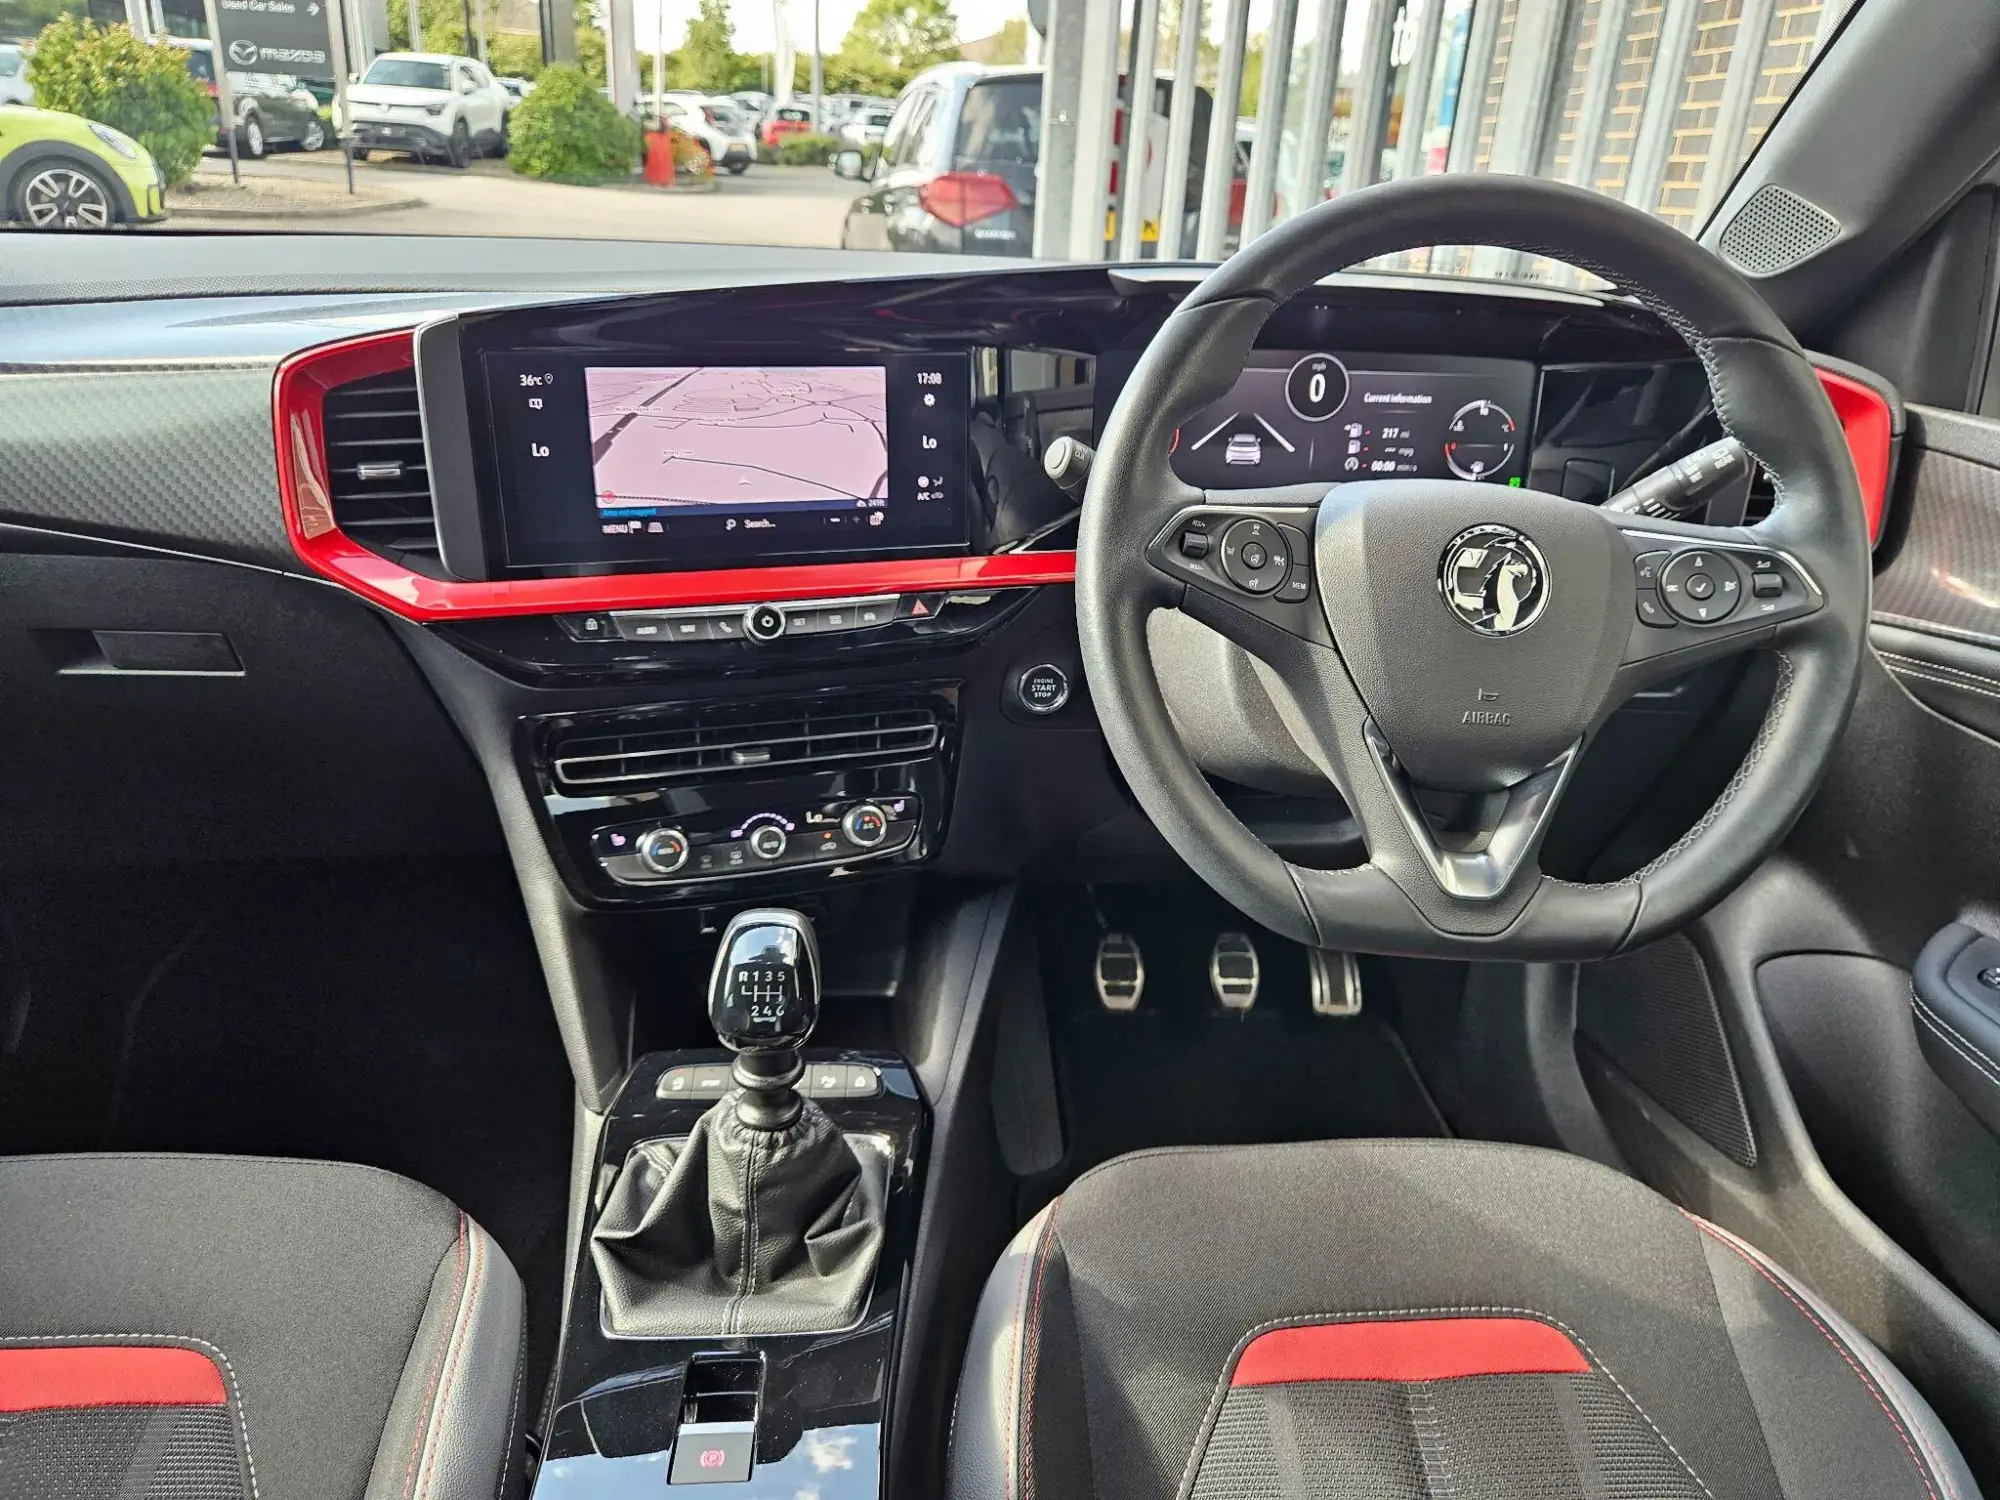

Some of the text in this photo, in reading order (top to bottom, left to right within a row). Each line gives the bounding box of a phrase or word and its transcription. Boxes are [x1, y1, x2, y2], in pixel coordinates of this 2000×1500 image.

[249, 0, 267, 11] Car
[268, 1, 295, 13] Sales
[1309, 373, 1326, 403] 0
[1364, 391, 1433, 404] Current information
[1382, 427, 1399, 439] 217
[922, 435, 938, 449] Lo
[531, 442, 550, 457] Lo
[1292, 581, 1307, 590] MEM
[1031, 684, 1056, 692] START
[1462, 710, 1511, 726] AIRBAG
[738, 970, 786, 982] R 1 3 5
[751, 1004, 785, 1016] 2 4 6
